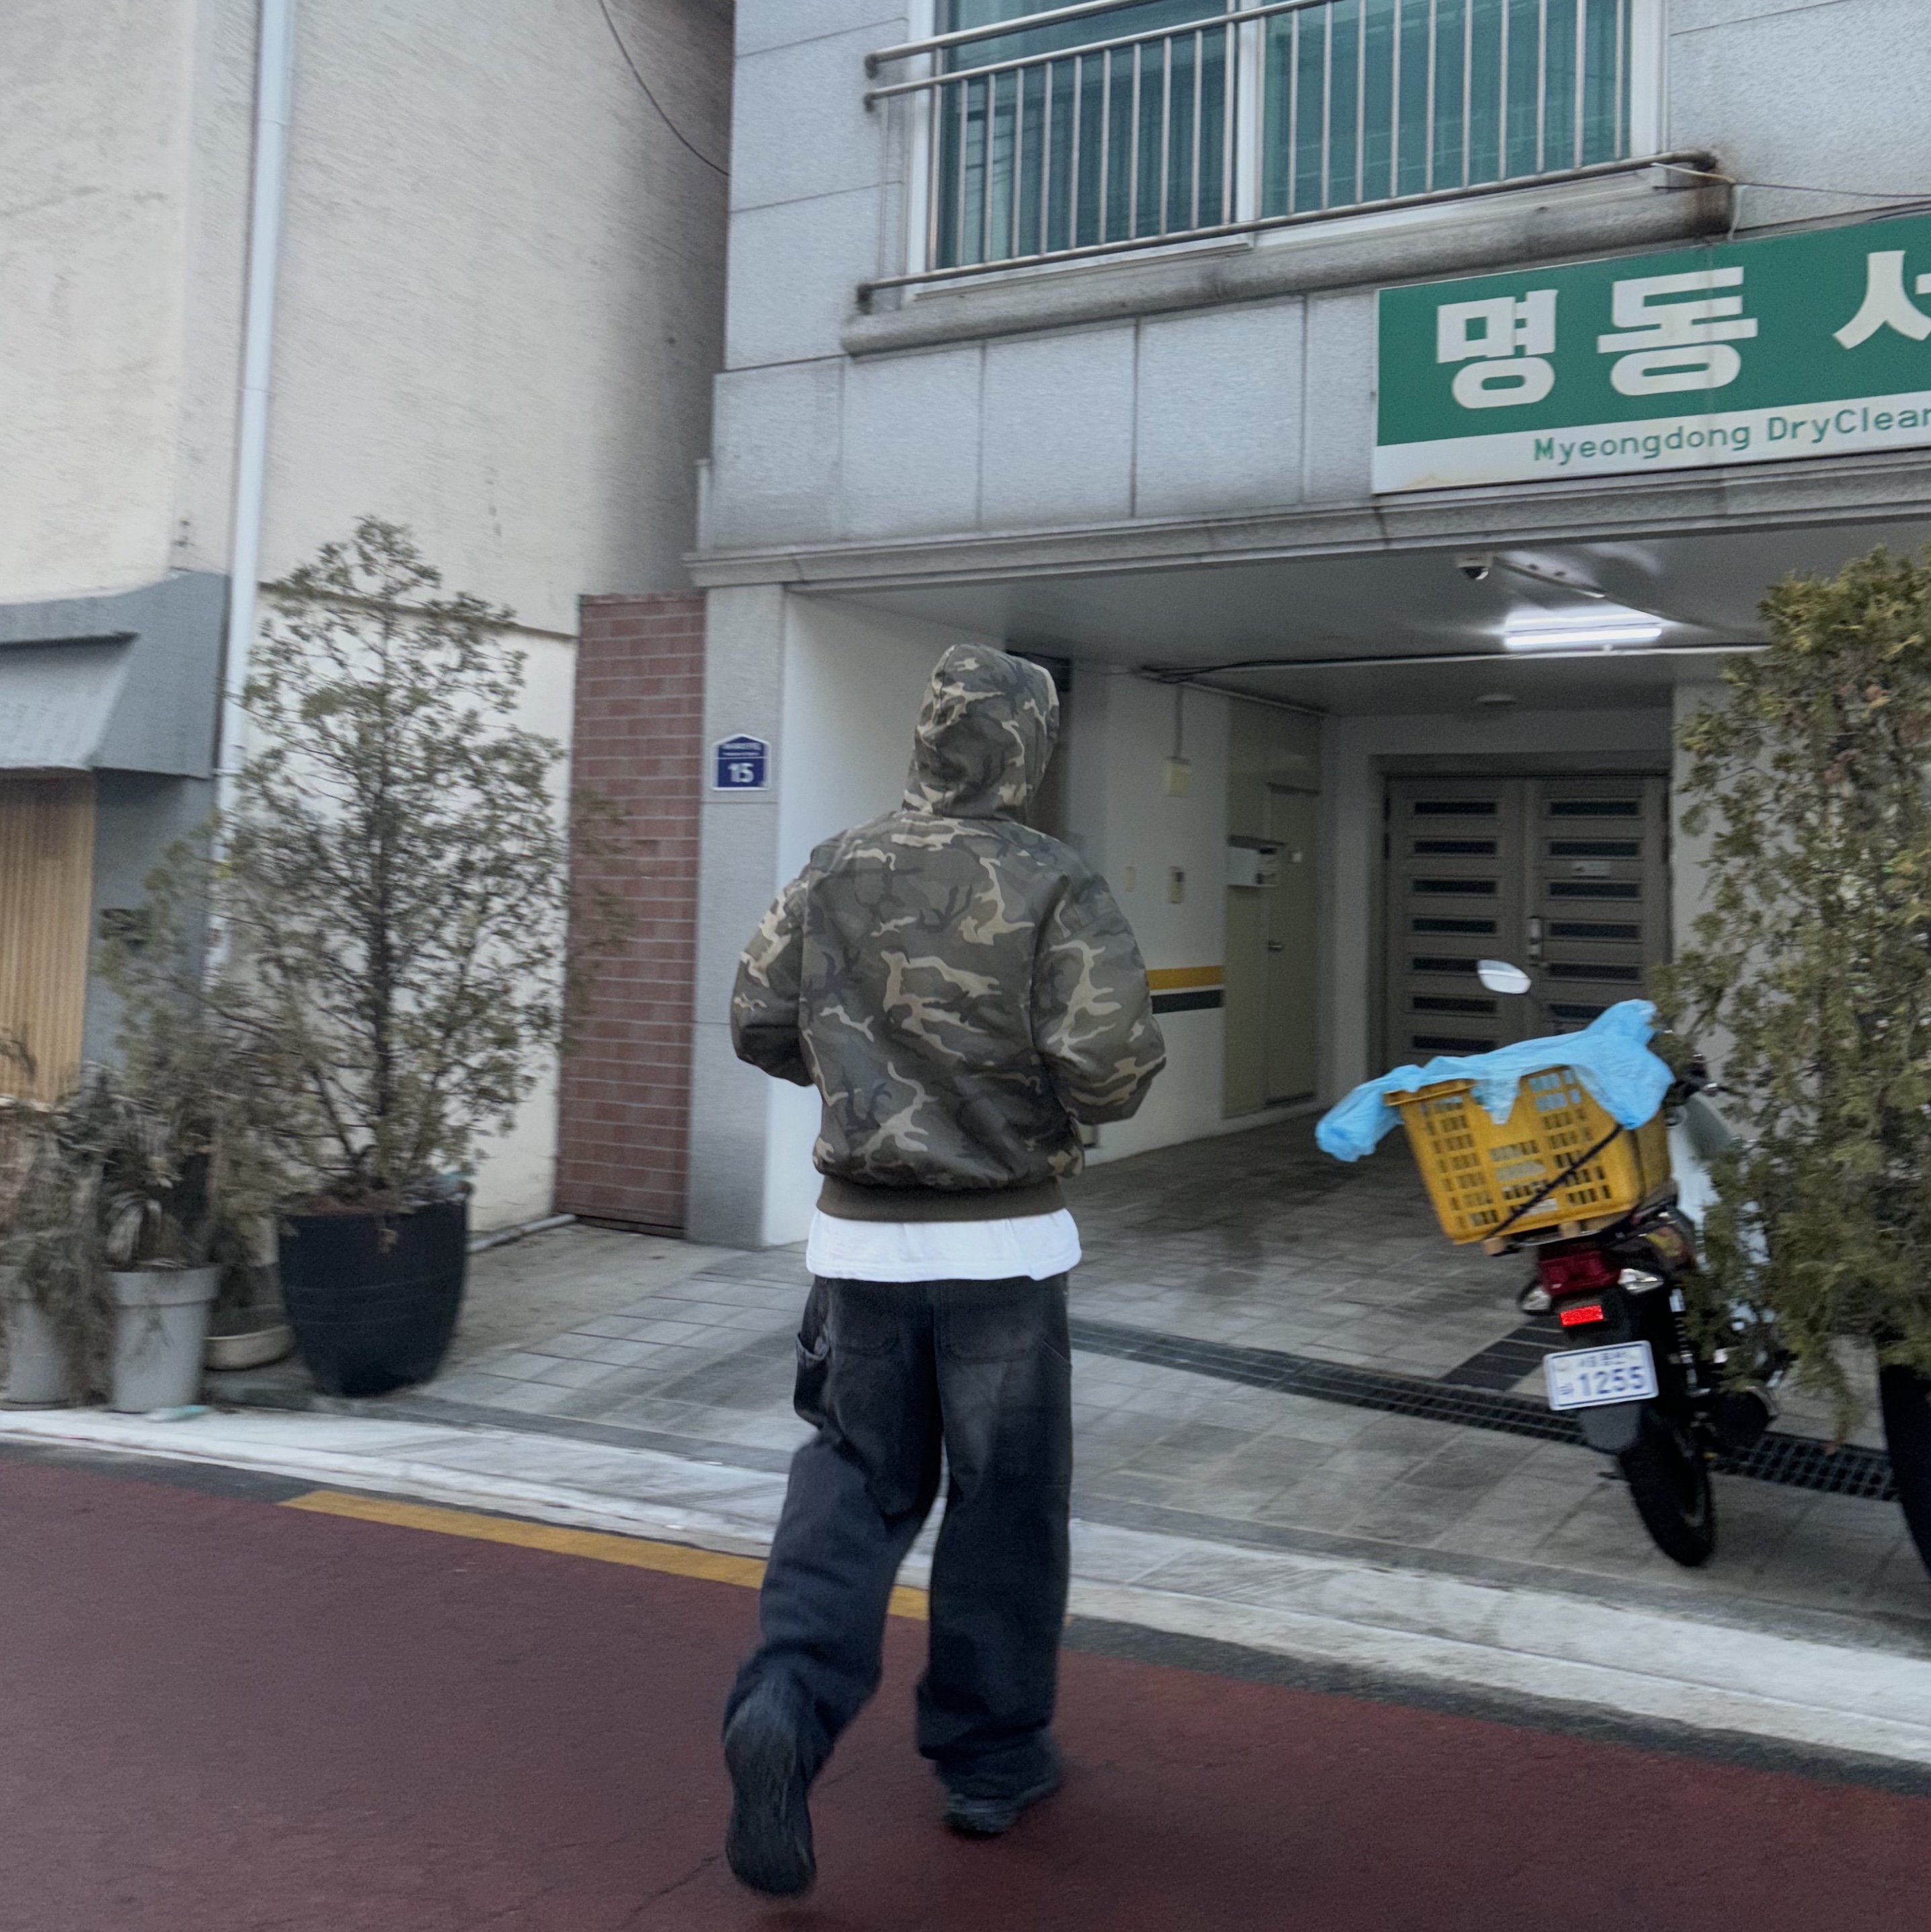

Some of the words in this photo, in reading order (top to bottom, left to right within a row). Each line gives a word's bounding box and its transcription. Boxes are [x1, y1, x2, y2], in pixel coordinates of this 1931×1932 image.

[1437, 266, 1758, 409] 명동
[1534, 426, 1751, 465] Myeongdong
[727, 763, 754, 783] 15
[1578, 1366, 1645, 1396] 1255
